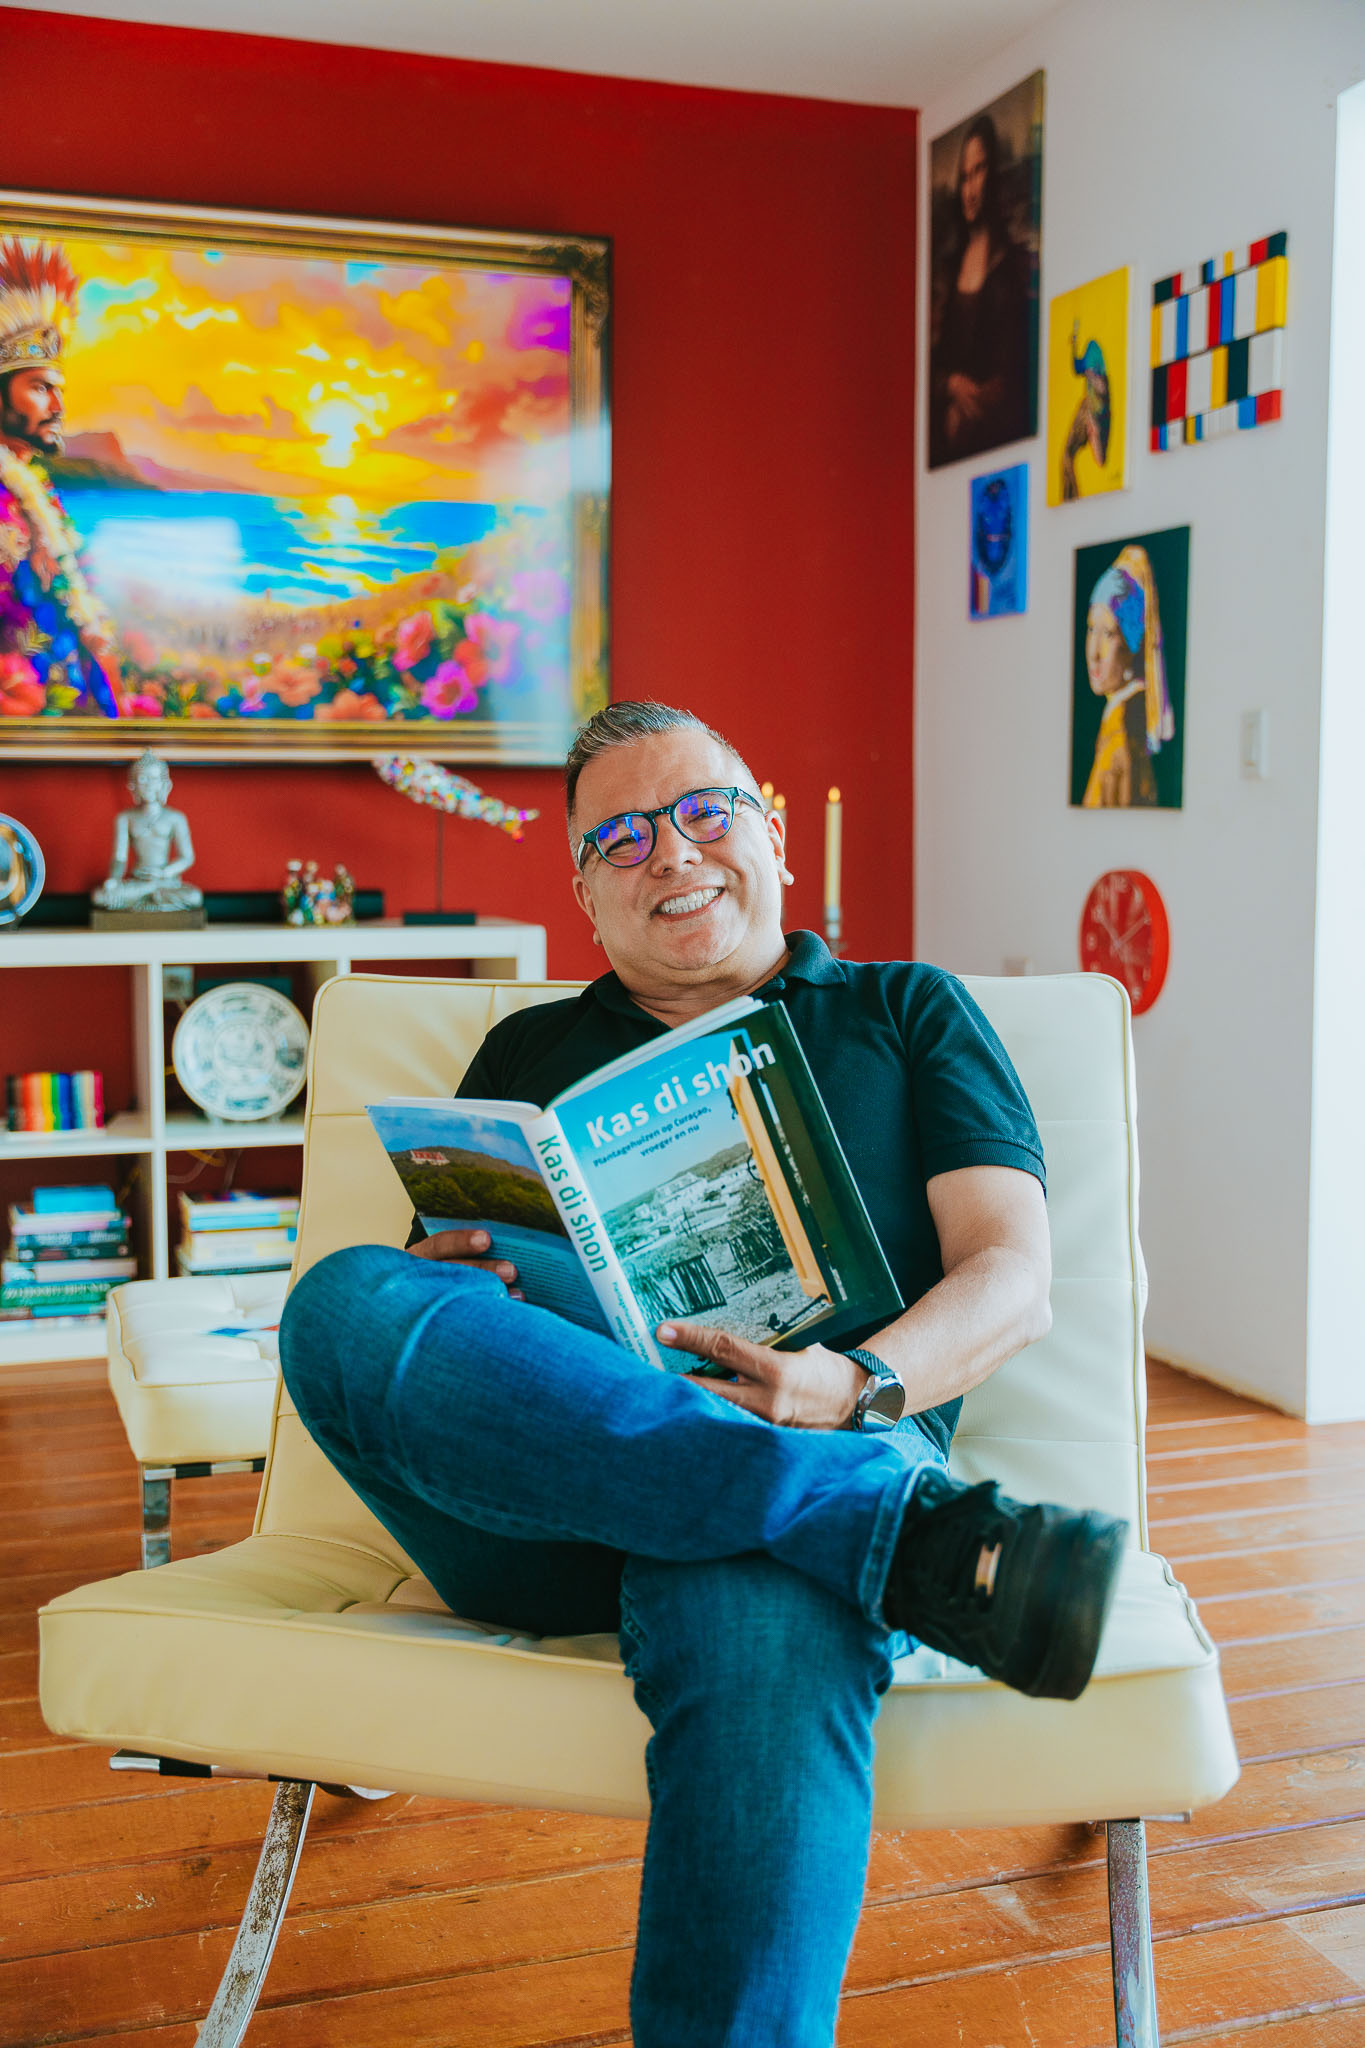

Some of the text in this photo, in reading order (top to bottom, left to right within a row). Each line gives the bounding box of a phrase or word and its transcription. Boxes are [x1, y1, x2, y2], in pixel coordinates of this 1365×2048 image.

[585, 1102, 649, 1148] Kas
[654, 1076, 688, 1115] di
[691, 1043, 776, 1097] shon
[593, 1130, 660, 1167] Plantagehuizen
[661, 1122, 673, 1134] op
[640, 1125, 700, 1156] vroeger en nu
[537, 1135, 608, 1273] Kas di shon
